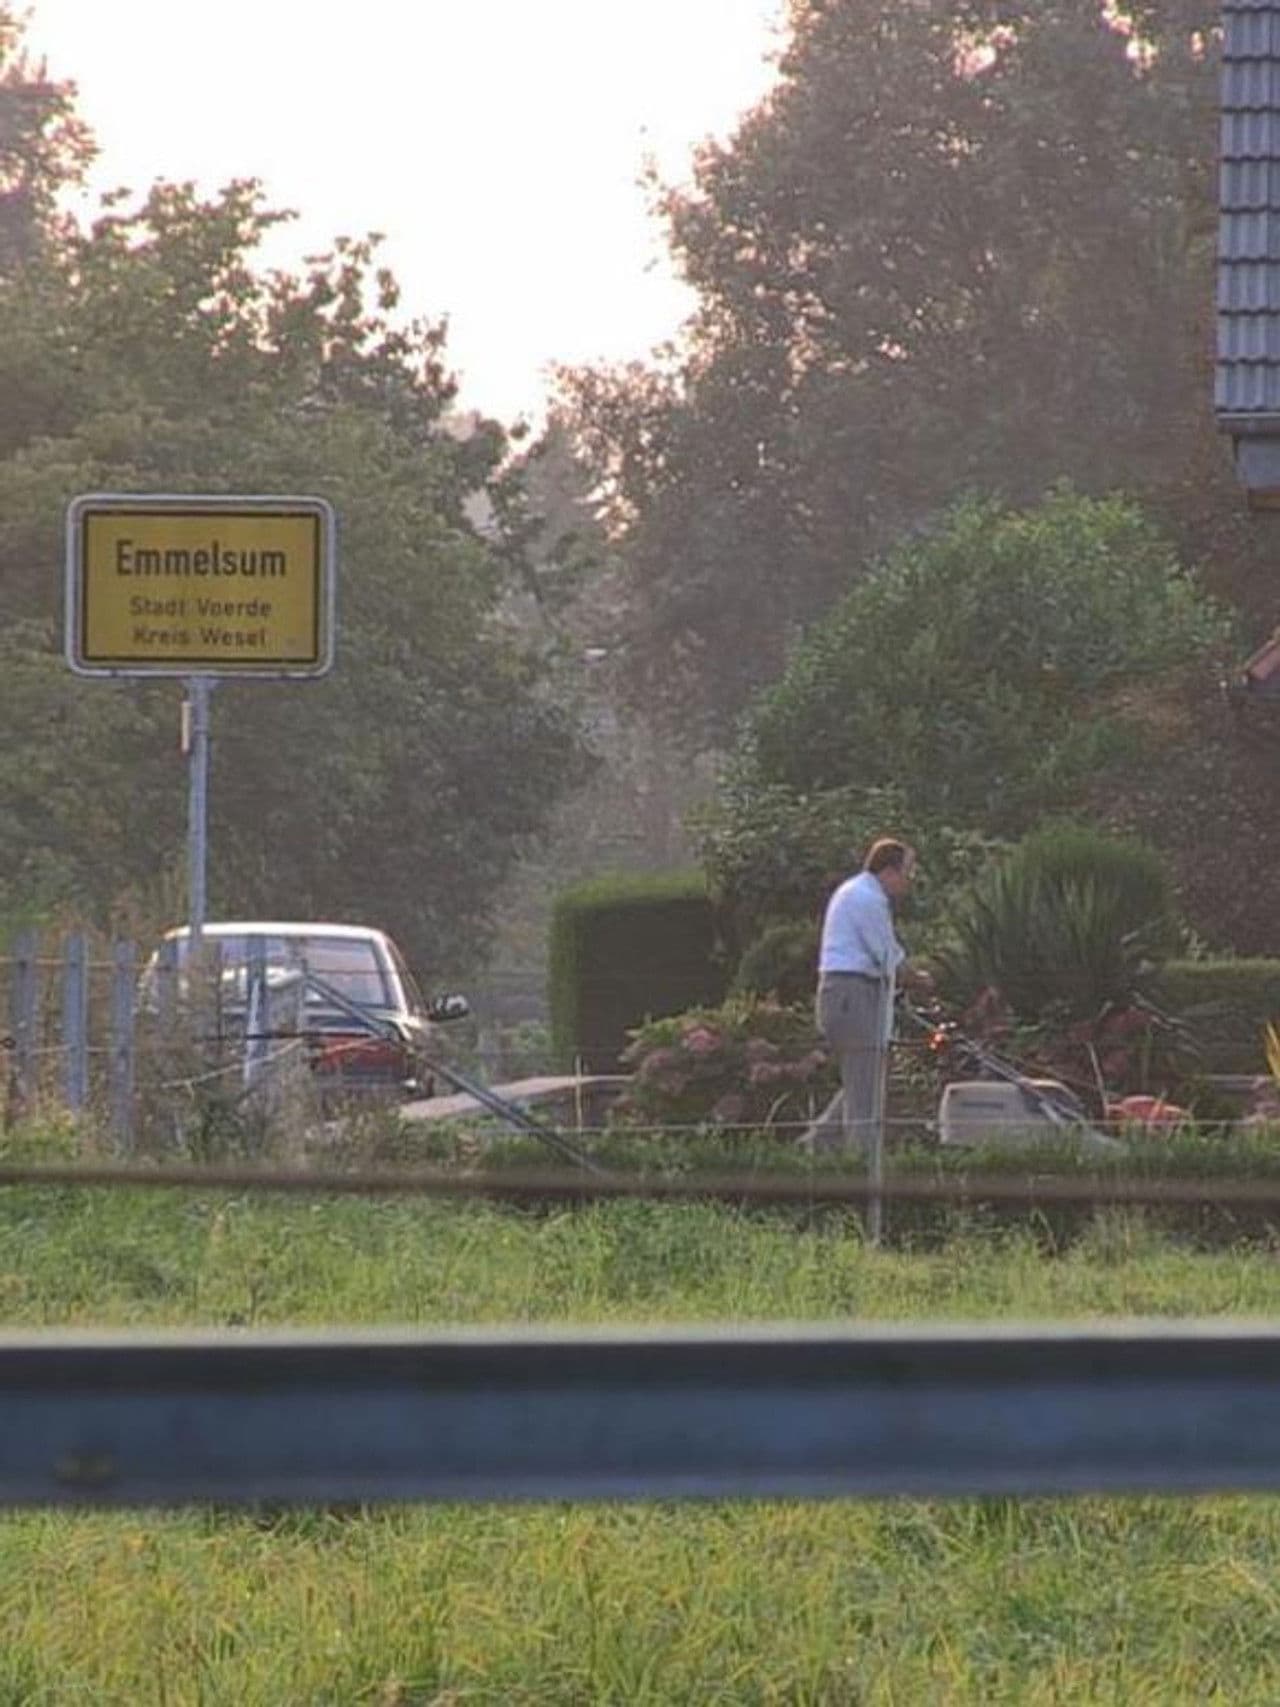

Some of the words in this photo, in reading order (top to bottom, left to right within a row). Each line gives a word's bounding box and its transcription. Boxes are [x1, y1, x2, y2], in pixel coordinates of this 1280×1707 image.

[116, 539, 286, 577] Emmelsum
[129, 596, 186, 618] Stadt
[197, 596, 272, 618] Voerde
[133, 626, 191, 646] Kreis
[200, 627, 266, 647] Wesel
